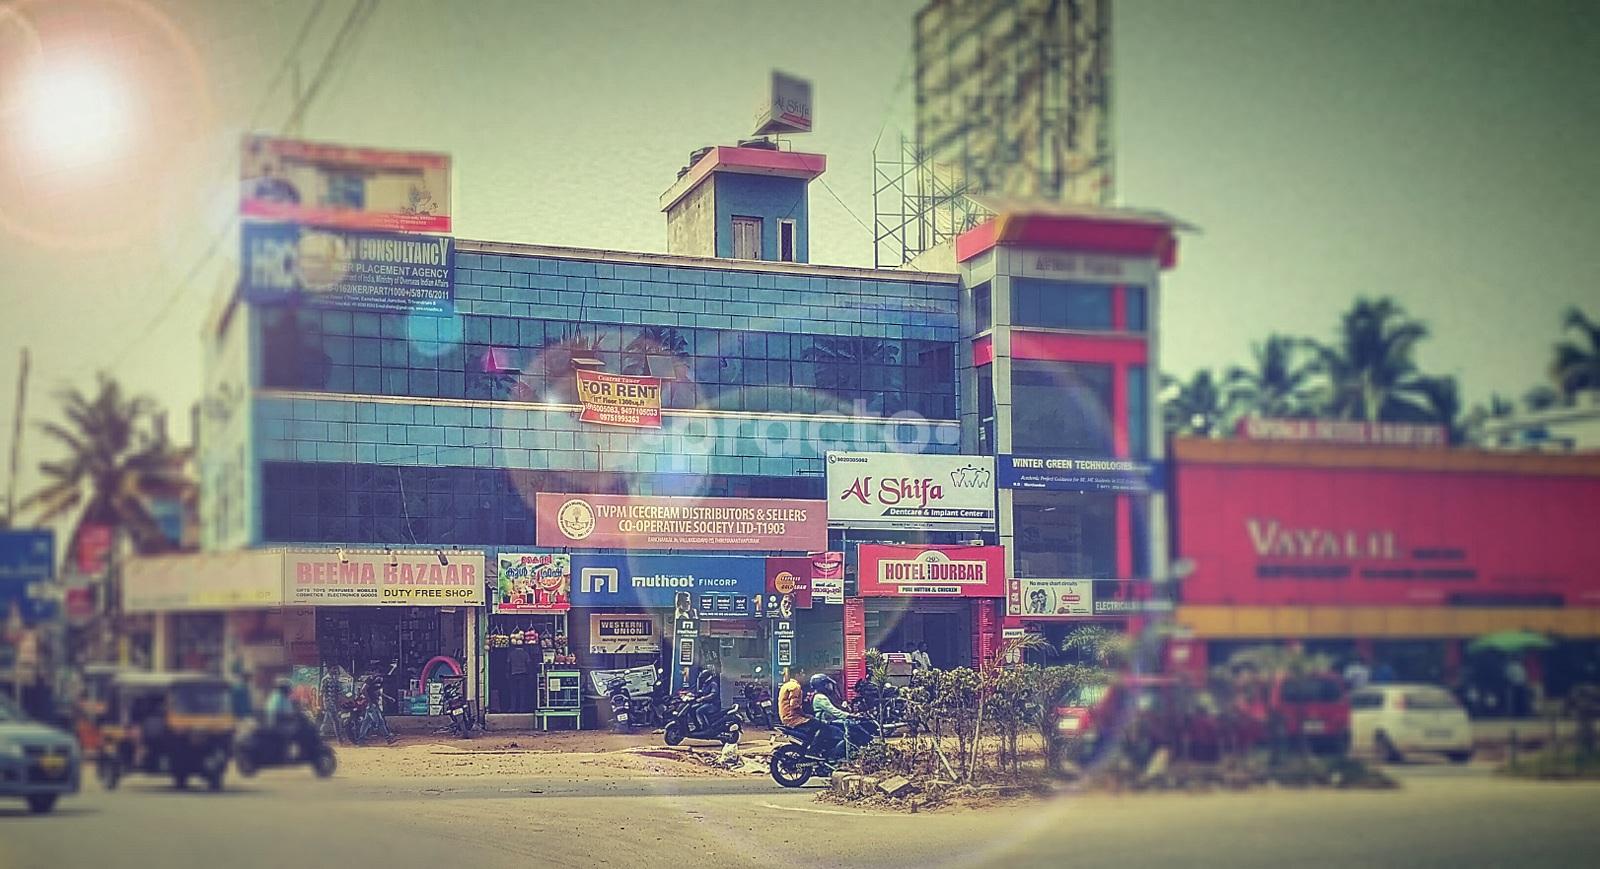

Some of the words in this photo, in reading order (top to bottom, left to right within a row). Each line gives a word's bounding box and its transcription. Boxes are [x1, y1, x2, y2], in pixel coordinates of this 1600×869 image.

[359, 237, 449, 266] CONSULTANCY
[356, 263, 410, 276] PLACEMENT
[412, 266, 449, 279] AGENCY
[420, 278, 434, 286] Indian
[434, 278, 449, 288] Affairs
[582, 381, 612, 395] FOR
[616, 383, 658, 399] RENT
[1012, 458, 1044, 469] WINTER
[1046, 459, 1072, 469] GREEN
[840, 477, 872, 505] Al
[878, 477, 944, 508] Shifa
[596, 505, 627, 518] TVPM
[629, 506, 680, 519] ICECREAM
[682, 507, 755, 520] DISTRIBUTORS
[757, 509, 765, 521] &
[766, 509, 807, 521] SELLERS
[889, 508, 922, 517] Dentcare
[923, 508, 930, 517] &
[931, 509, 959, 518] Implant
[960, 510, 984, 518] Center
[618, 520, 692, 532] CO-OPERATIVE
[694, 521, 735, 534] SOCIETY
[736, 522, 785, 534] LTD-T1903
[296, 562, 376, 585] BEEMA
[383, 563, 475, 585] BAZAAR
[885, 563, 926, 580] HOTEL
[930, 564, 983, 580] DURBAR
[631, 574, 694, 588] muthoot
[699, 578, 738, 586] FINCORP
[384, 589, 411, 597] DUTY
[445, 589, 473, 598] SHOP
[601, 621, 642, 629] WESTERN
